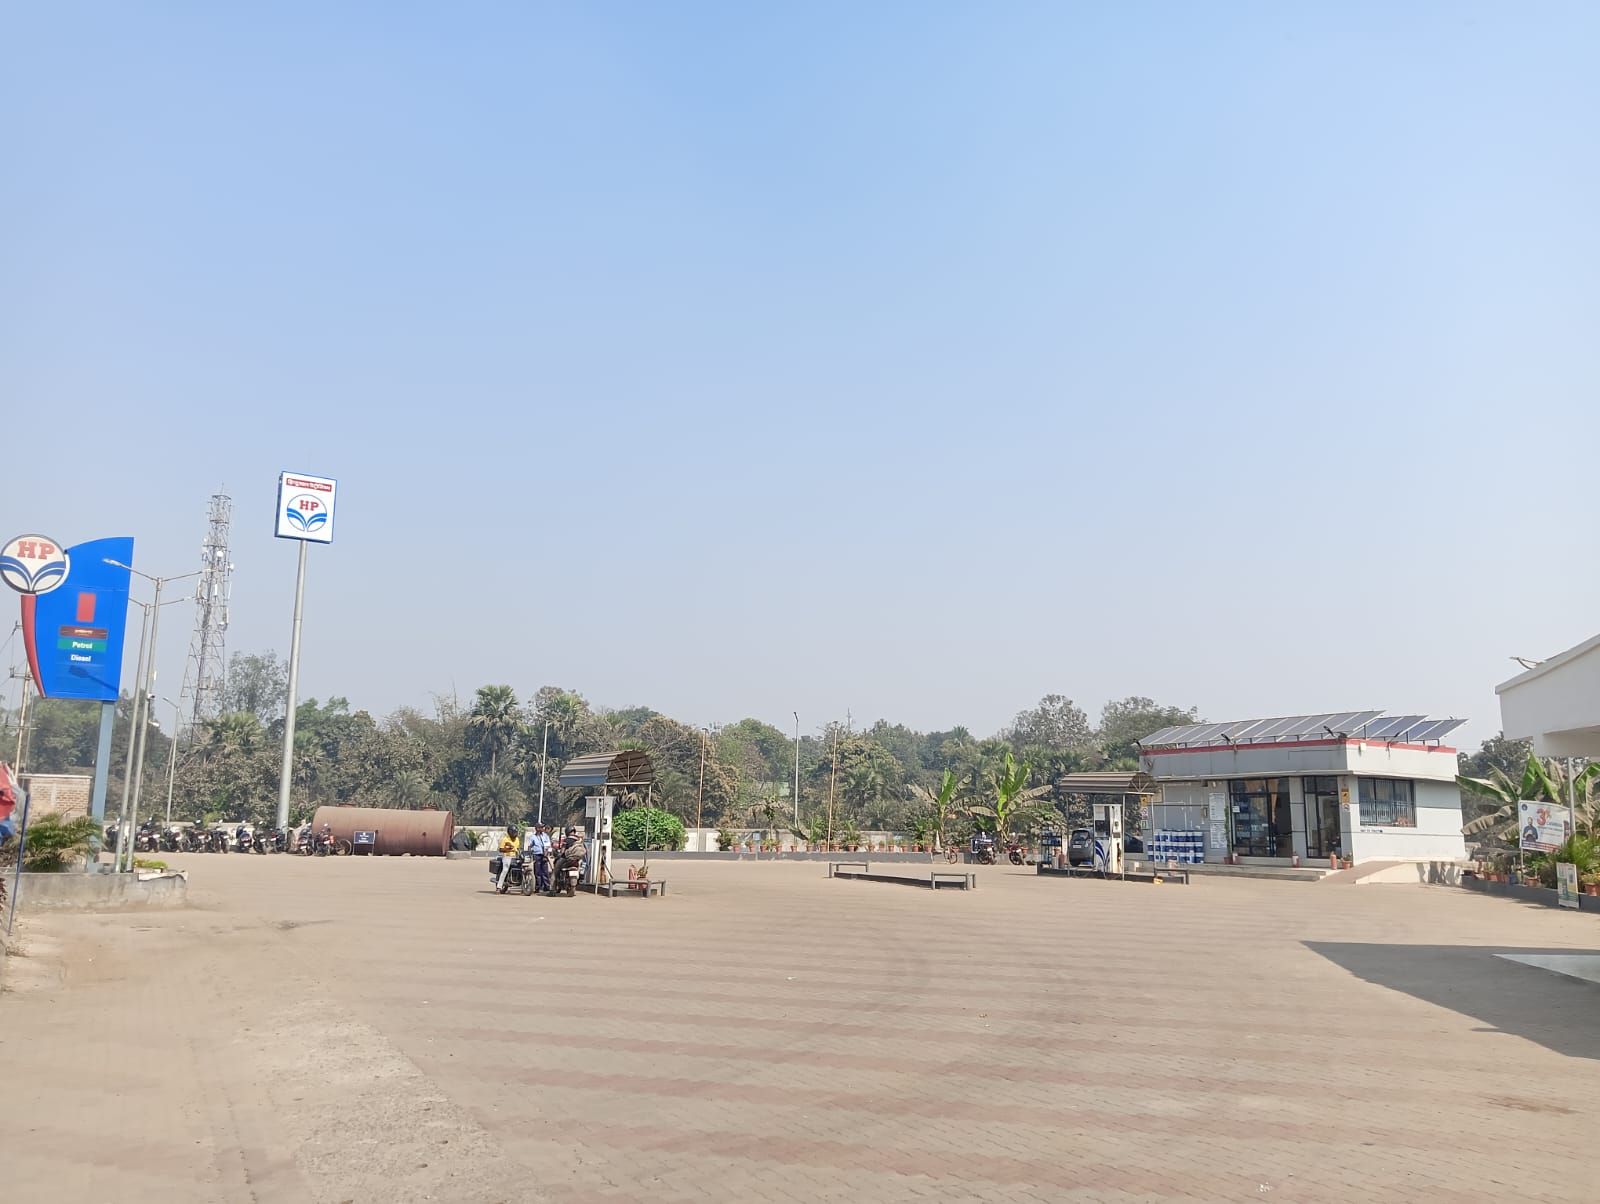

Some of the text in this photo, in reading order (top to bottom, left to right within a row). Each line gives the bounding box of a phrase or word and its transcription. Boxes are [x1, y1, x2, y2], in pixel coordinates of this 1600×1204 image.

[299, 499, 319, 511] HP
[17, 540, 56, 560] HP
[72, 641, 93, 649] Petrol
[71, 654, 91, 662] Diesel
